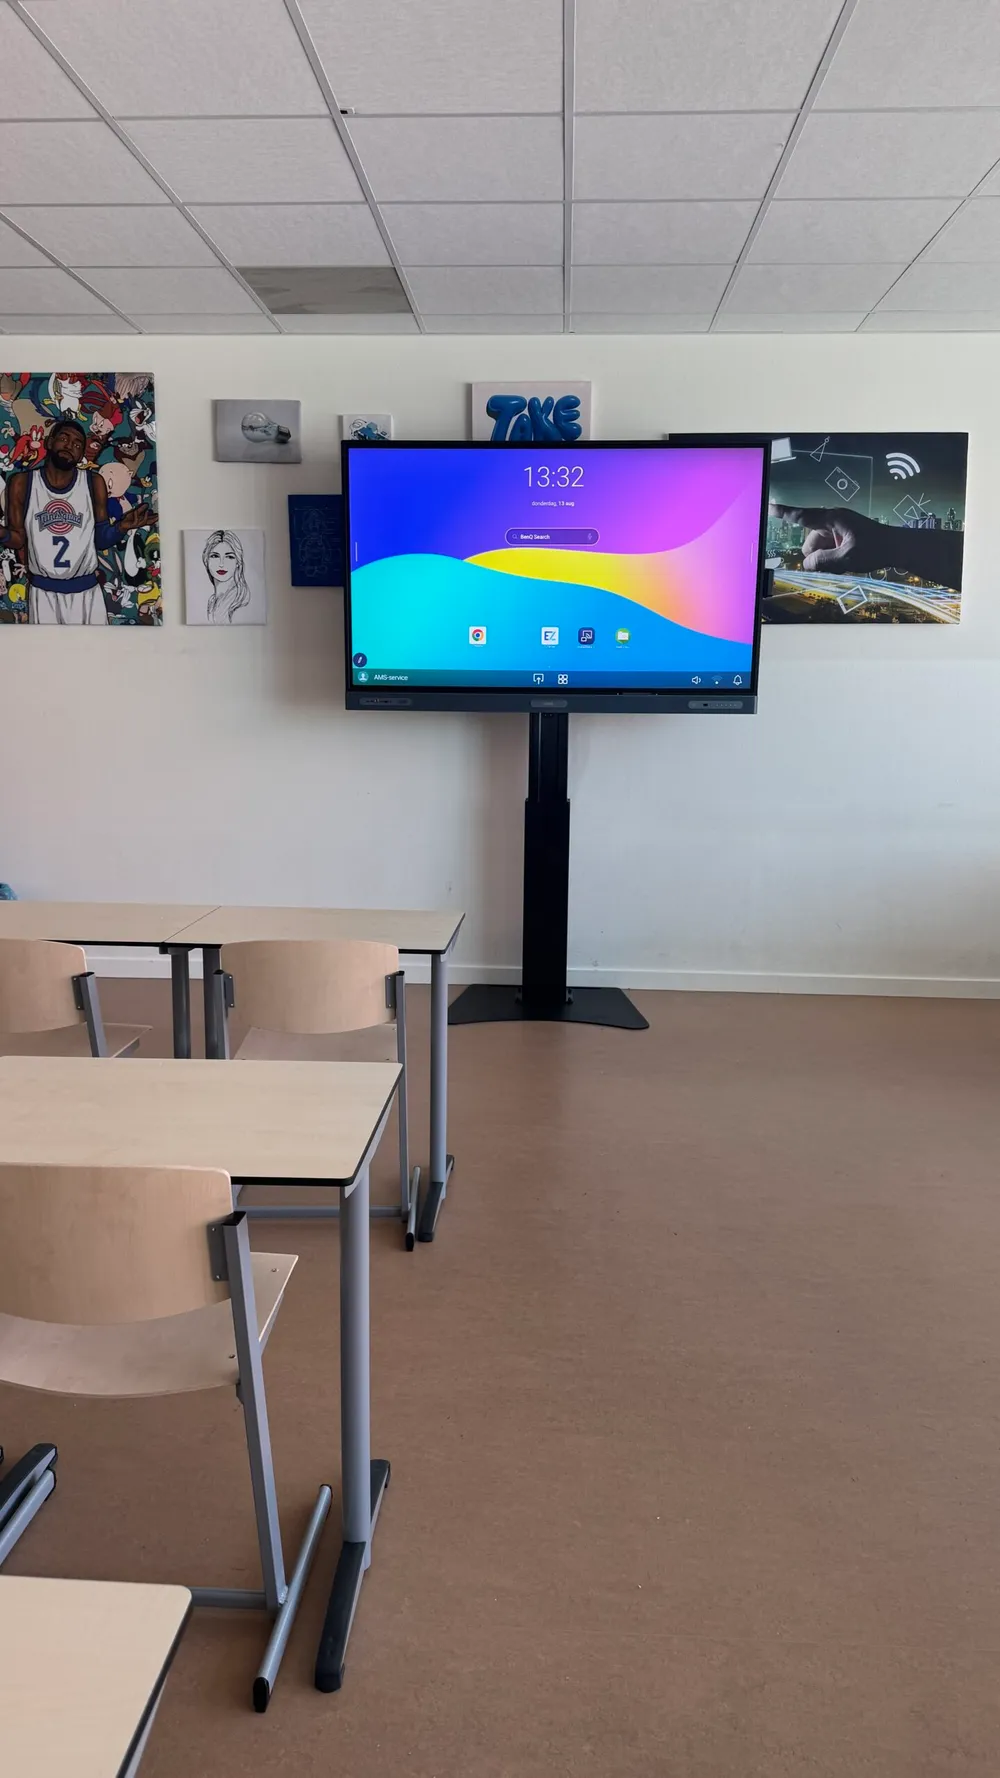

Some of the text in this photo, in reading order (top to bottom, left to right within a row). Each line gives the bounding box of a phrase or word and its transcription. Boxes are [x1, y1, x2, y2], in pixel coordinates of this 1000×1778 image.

[486, 394, 582, 441] TAKE
[523, 466, 584, 488] 13:32
[52, 536, 71, 568] 2
[373, 673, 409, 682] AMS-service
